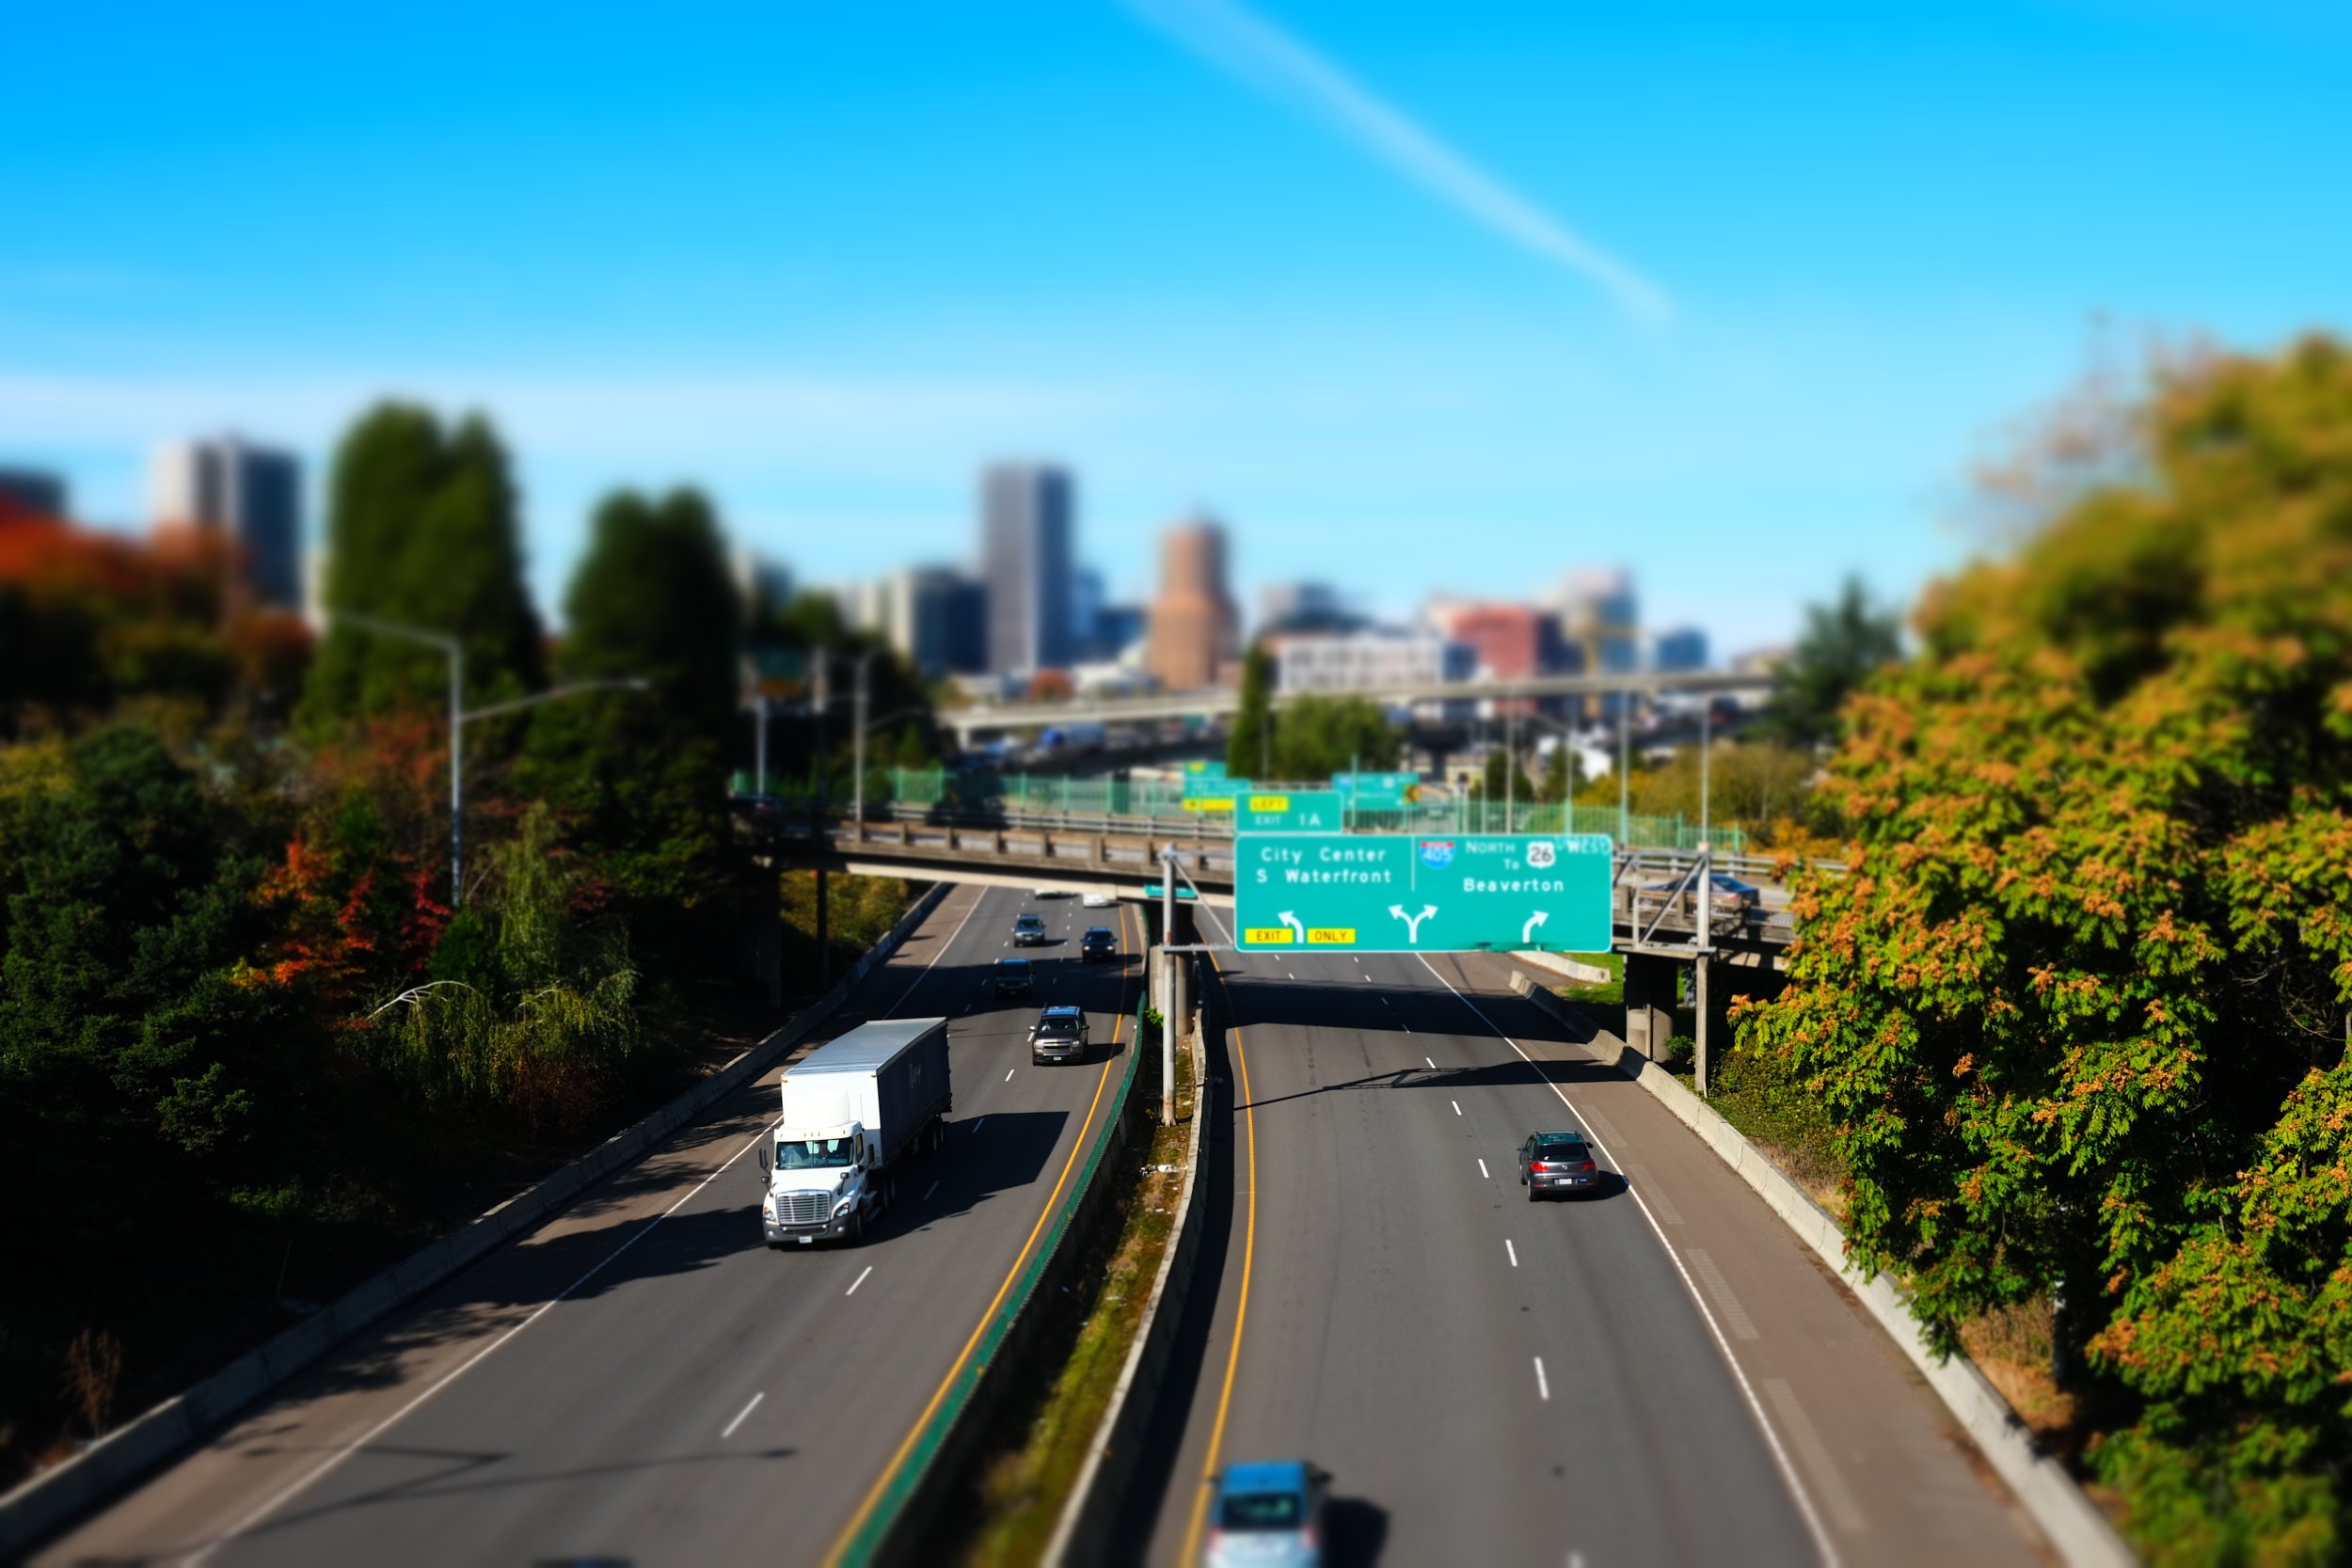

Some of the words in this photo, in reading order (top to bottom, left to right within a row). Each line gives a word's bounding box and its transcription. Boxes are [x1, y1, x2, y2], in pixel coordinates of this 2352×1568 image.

[1253, 798, 1284, 809] LEFT
[1255, 815, 1281, 825] EXIT
[1299, 813, 1322, 826] 1A
[1466, 841, 1516, 853] NORTH
[1261, 847, 1302, 864] City
[1319, 847, 1386, 862] Center
[1422, 847, 1453, 862] 405
[1530, 846, 1553, 863] 26
[1503, 858, 1519, 870] To
[1256, 868, 1268, 883] S
[1285, 868, 1391, 883] Waterfront
[1463, 878, 1565, 892] Beaverton
[1256, 930, 1281, 942] EXIT
[1314, 930, 1347, 942] ONLY
